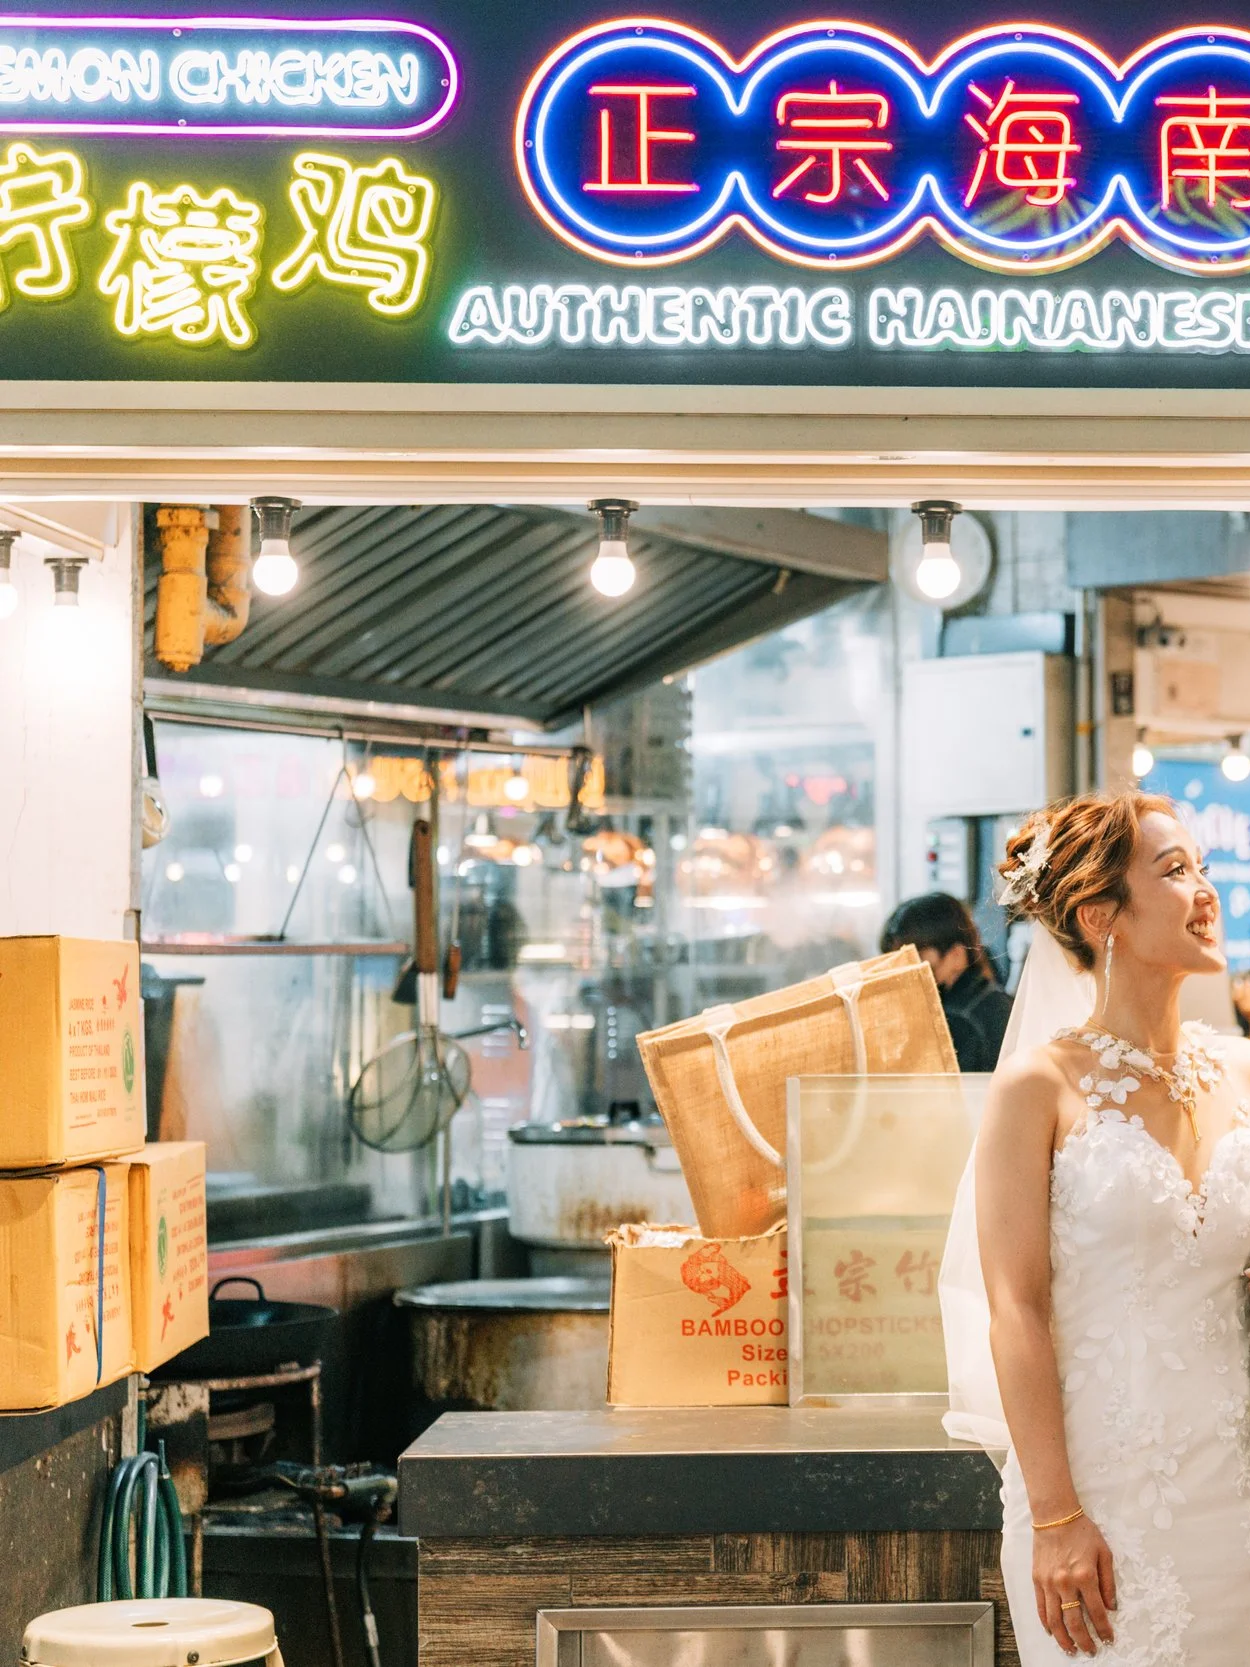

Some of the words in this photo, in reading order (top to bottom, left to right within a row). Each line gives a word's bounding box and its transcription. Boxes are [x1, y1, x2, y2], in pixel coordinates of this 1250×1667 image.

[169, 50, 420, 106] CHICKEN
[449, 284, 852, 346] AUTHENTIC
[681, 1319, 785, 1336] BAMBOO
[808, 1316, 944, 1335] HOPSTICKS
[742, 1344, 788, 1361] Size
[728, 1369, 788, 1386] Packi
